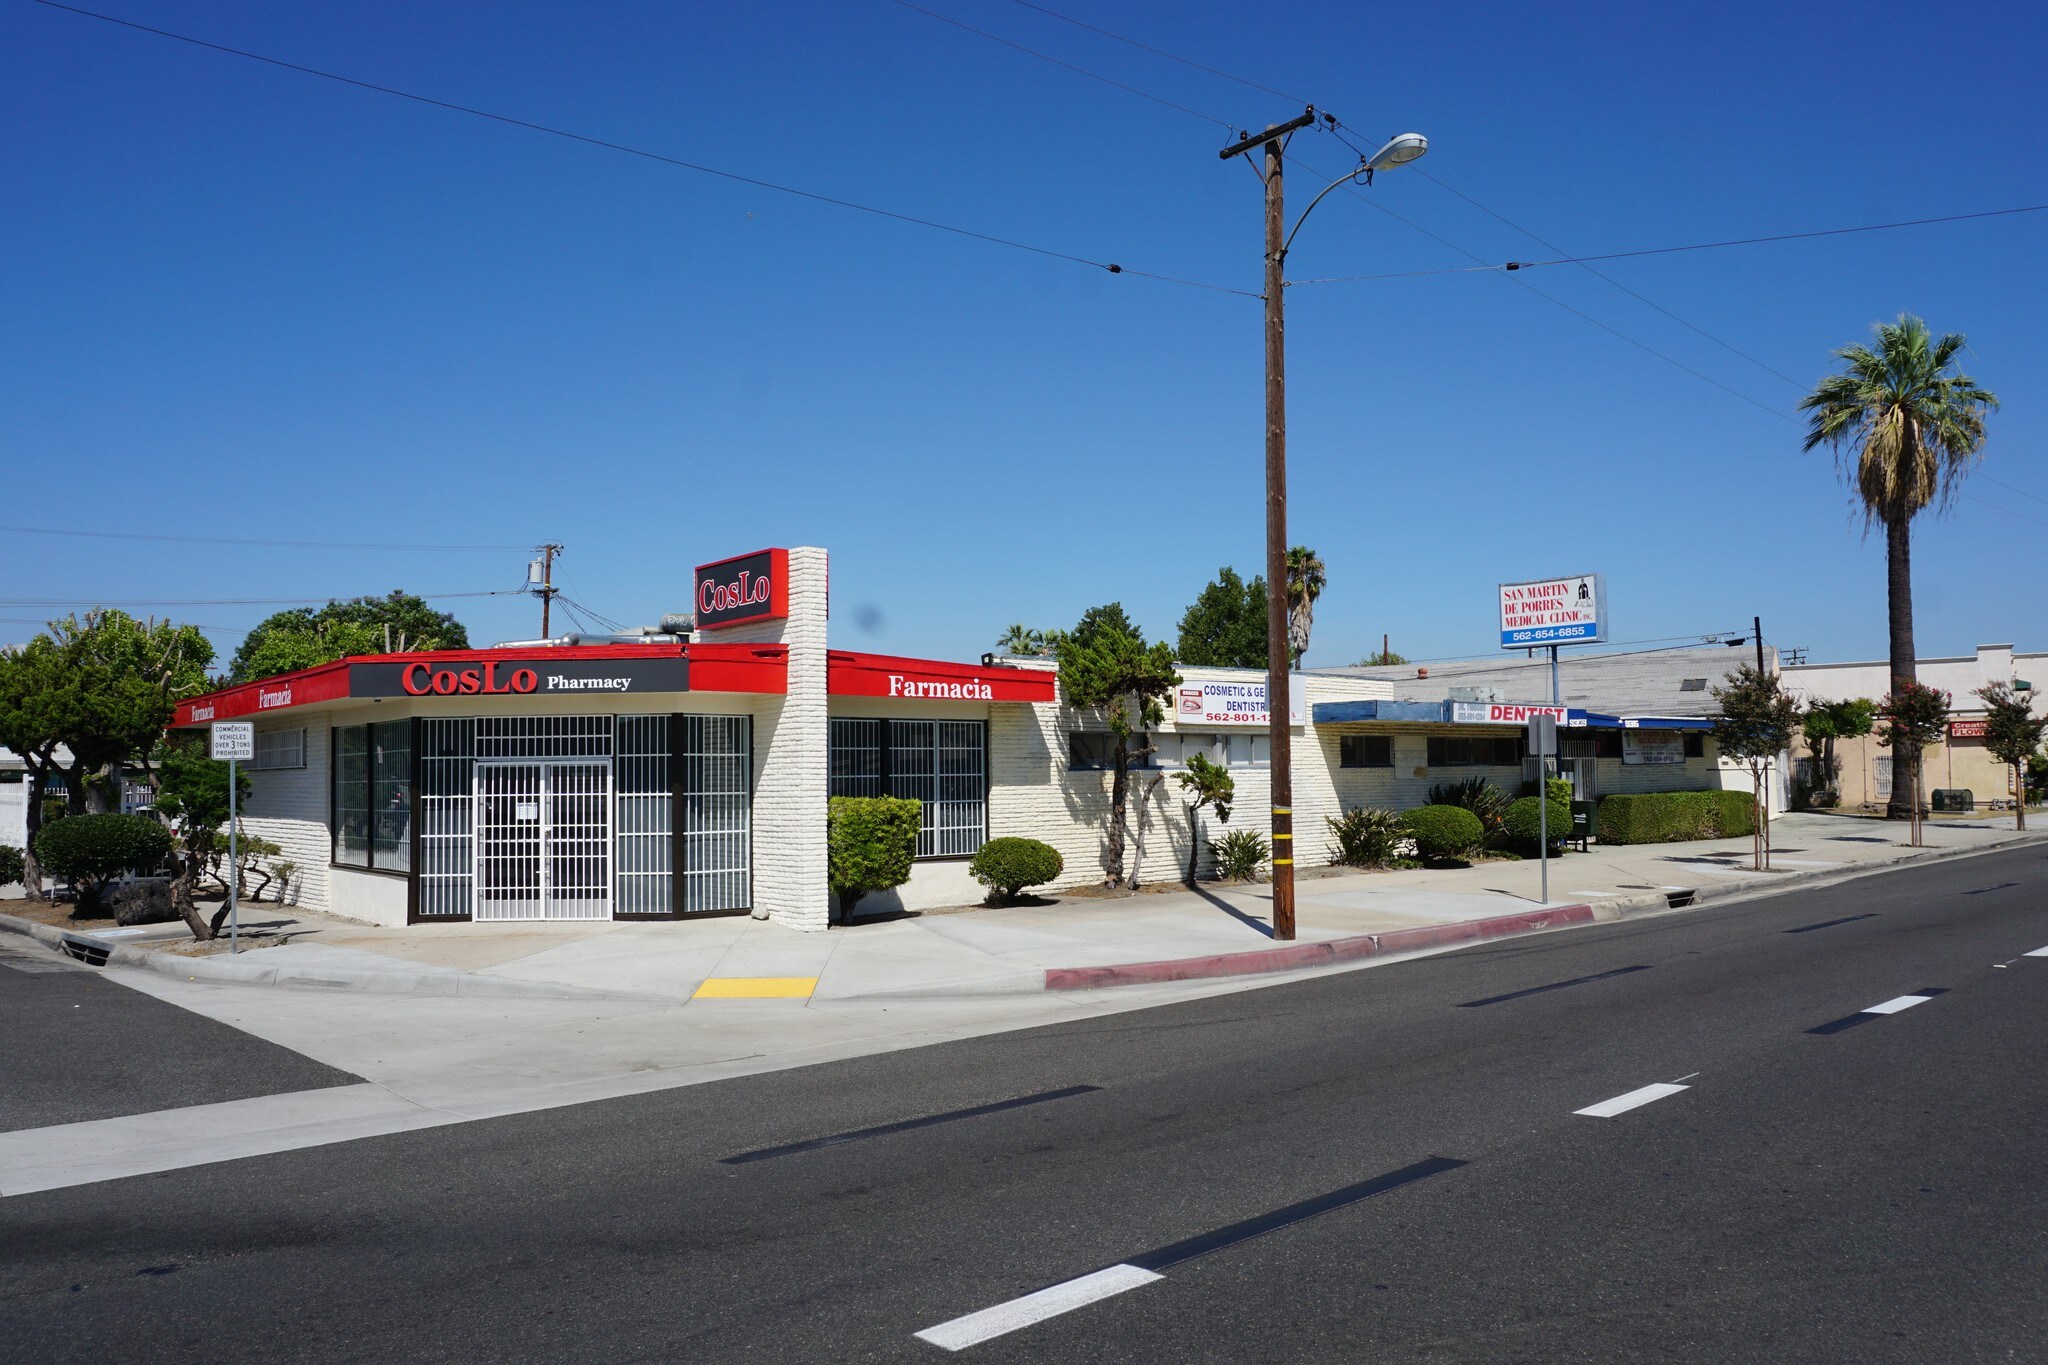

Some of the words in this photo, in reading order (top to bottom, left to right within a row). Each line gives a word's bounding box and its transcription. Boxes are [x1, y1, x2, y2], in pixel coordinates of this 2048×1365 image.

[699, 571, 770, 614] CosLo
[1504, 589, 1524, 601] SAN
[1528, 584, 1569, 598] MARTIN
[1504, 602, 1518, 615] DE
[1521, 599, 1563, 612] PORRES
[1505, 614, 1546, 627] MEDICAL
[1550, 610, 1582, 624] CLINIC
[1513, 627, 1584, 640] 562-654-6855
[402, 662, 538, 695] CosLo
[547, 675, 632, 691] Pharmacy
[259, 684, 291, 708] Farmacia
[888, 675, 993, 700] Farmacia
[1204, 685, 1245, 697] COSMETIC
[1247, 687, 1253, 697] &
[192, 701, 214, 721] Farmacia
[1206, 713, 1271, 722] 562-801-1
[231, 741, 236, 750] 3
